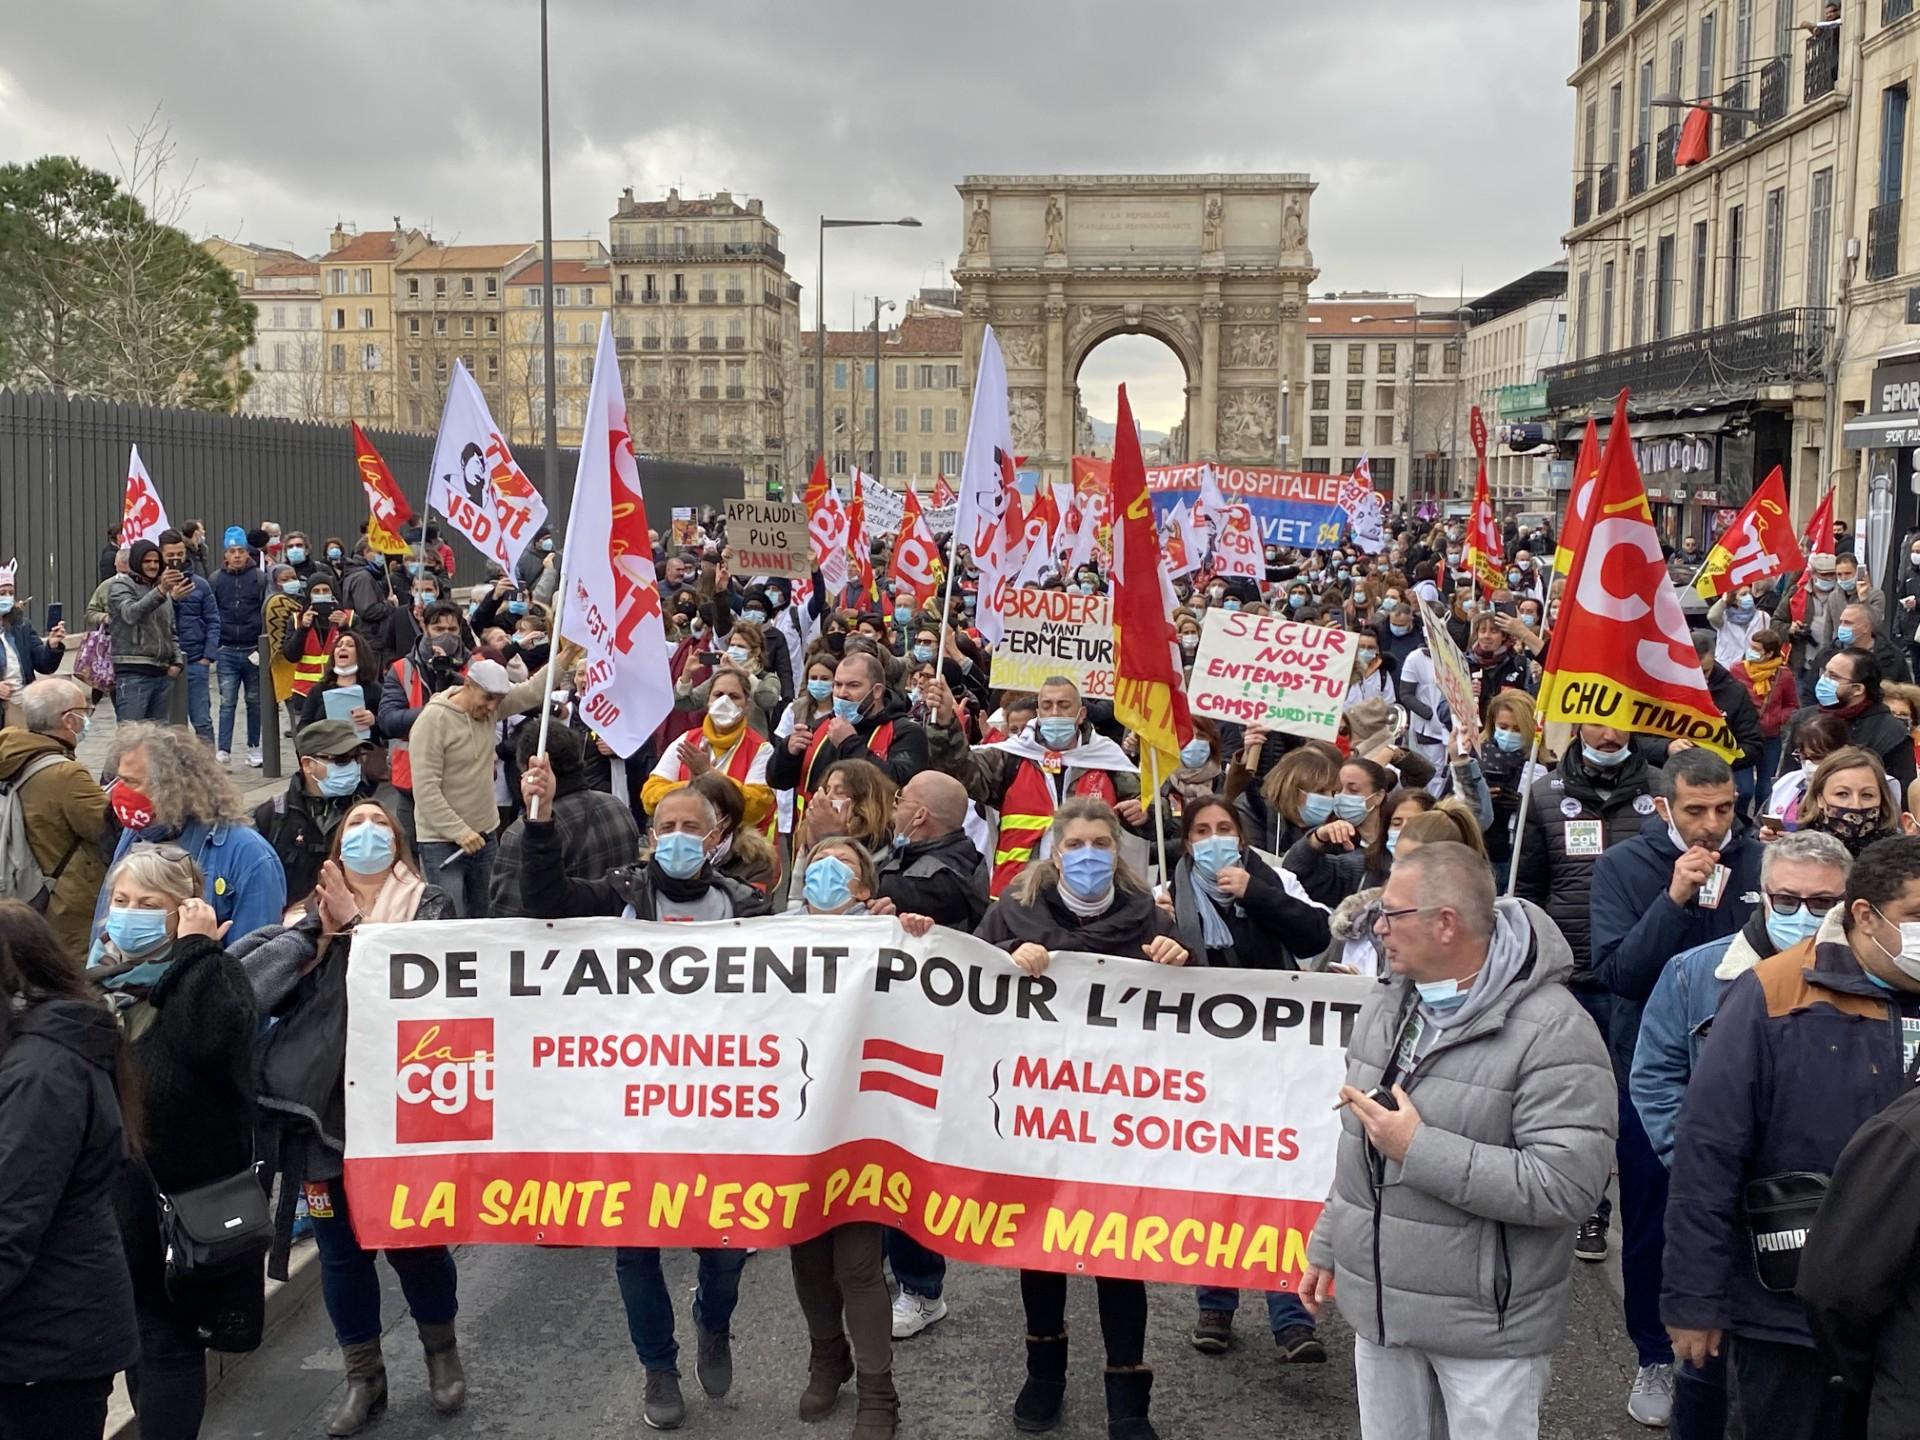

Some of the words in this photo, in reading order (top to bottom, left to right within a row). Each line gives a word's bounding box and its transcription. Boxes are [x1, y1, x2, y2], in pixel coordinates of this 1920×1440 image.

[1222, 531, 1256, 555] cgt
[1317, 522, 1340, 544] 84
[1234, 561, 1257, 576] 06
[586, 604, 608, 643] CGT
[1041, 622, 1084, 636] AVANT
[1222, 613, 1347, 654] SEGUR
[1255, 646, 1330, 672] NOUS
[1207, 658, 1343, 699] ENTENDS-TU
[584, 692, 621, 728] SUD
[1196, 692, 1268, 720] CAMSP
[1560, 682, 1623, 717] CHU
[130, 809, 151, 827] 13
[1571, 832, 1599, 845] cgt
[389, 951, 479, 1000] DE
[509, 946, 849, 997] L'ARGENT
[874, 947, 1060, 1024] POUR
[401, 1024, 484, 1064] la
[532, 1033, 781, 1069] PERSONNELS
[396, 1050, 495, 1115] cgt
[1011, 1055, 1208, 1104] MALADES
[624, 1083, 781, 1119] EPUISES
[1013, 1104, 1098, 1144] MAL
[1111, 1112, 1301, 1162] SOIGNES
[308, 1192, 332, 1210] cgt
[389, 1181, 457, 1229] LA
[478, 1178, 631, 1229] SANTE
[648, 1173, 810, 1231] N'EST
[822, 1162, 913, 1218] PAS
[922, 1189, 1026, 1249] UNE
